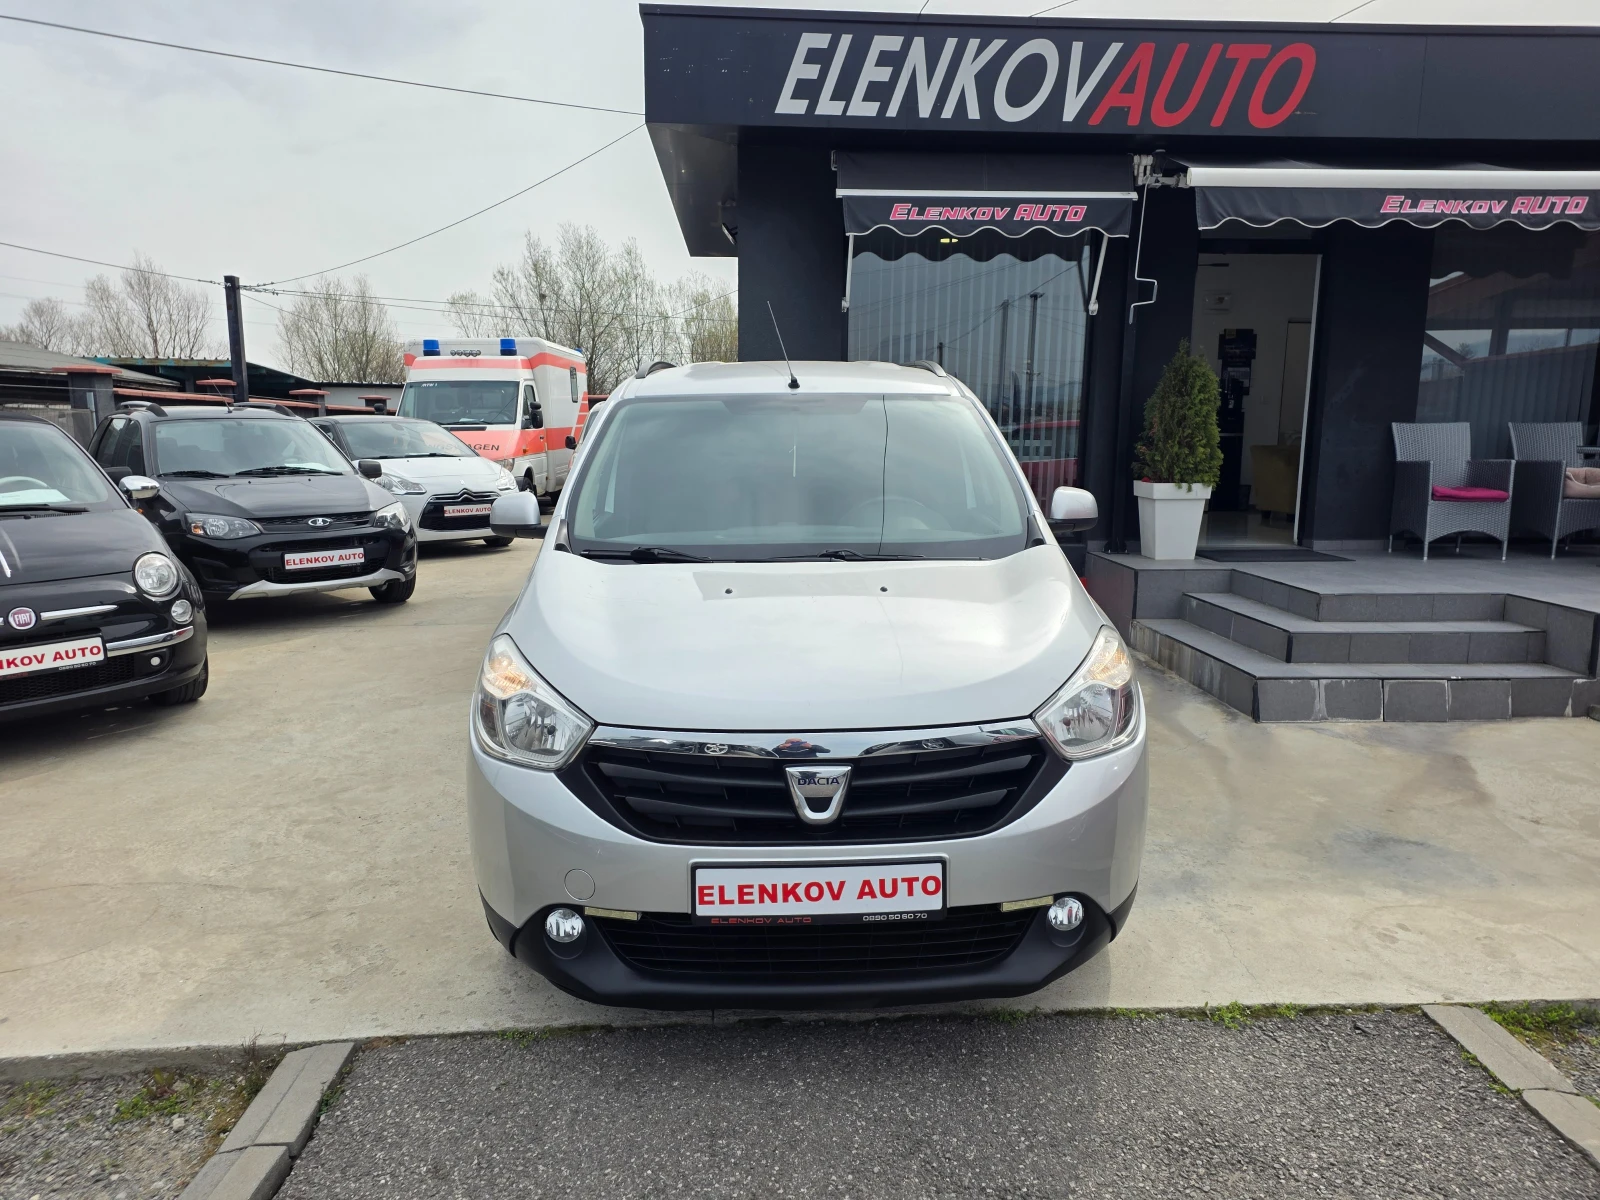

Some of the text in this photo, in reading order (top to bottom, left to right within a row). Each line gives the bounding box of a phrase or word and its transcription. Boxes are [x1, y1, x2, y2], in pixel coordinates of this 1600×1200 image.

[1013, 204, 1088, 222] AUTO
[1510, 196, 1589, 215] AUTO
[286, 555, 335, 566] ELENKOV
[338, 552, 364, 562] AUTO
[14, 614, 31, 625] FIAT
[0, 653, 45, 671] KOV
[53, 645, 102, 662] AUTO
[797, 777, 840, 786] DACIA
[697, 875, 942, 906] ELENKOV AUTO
